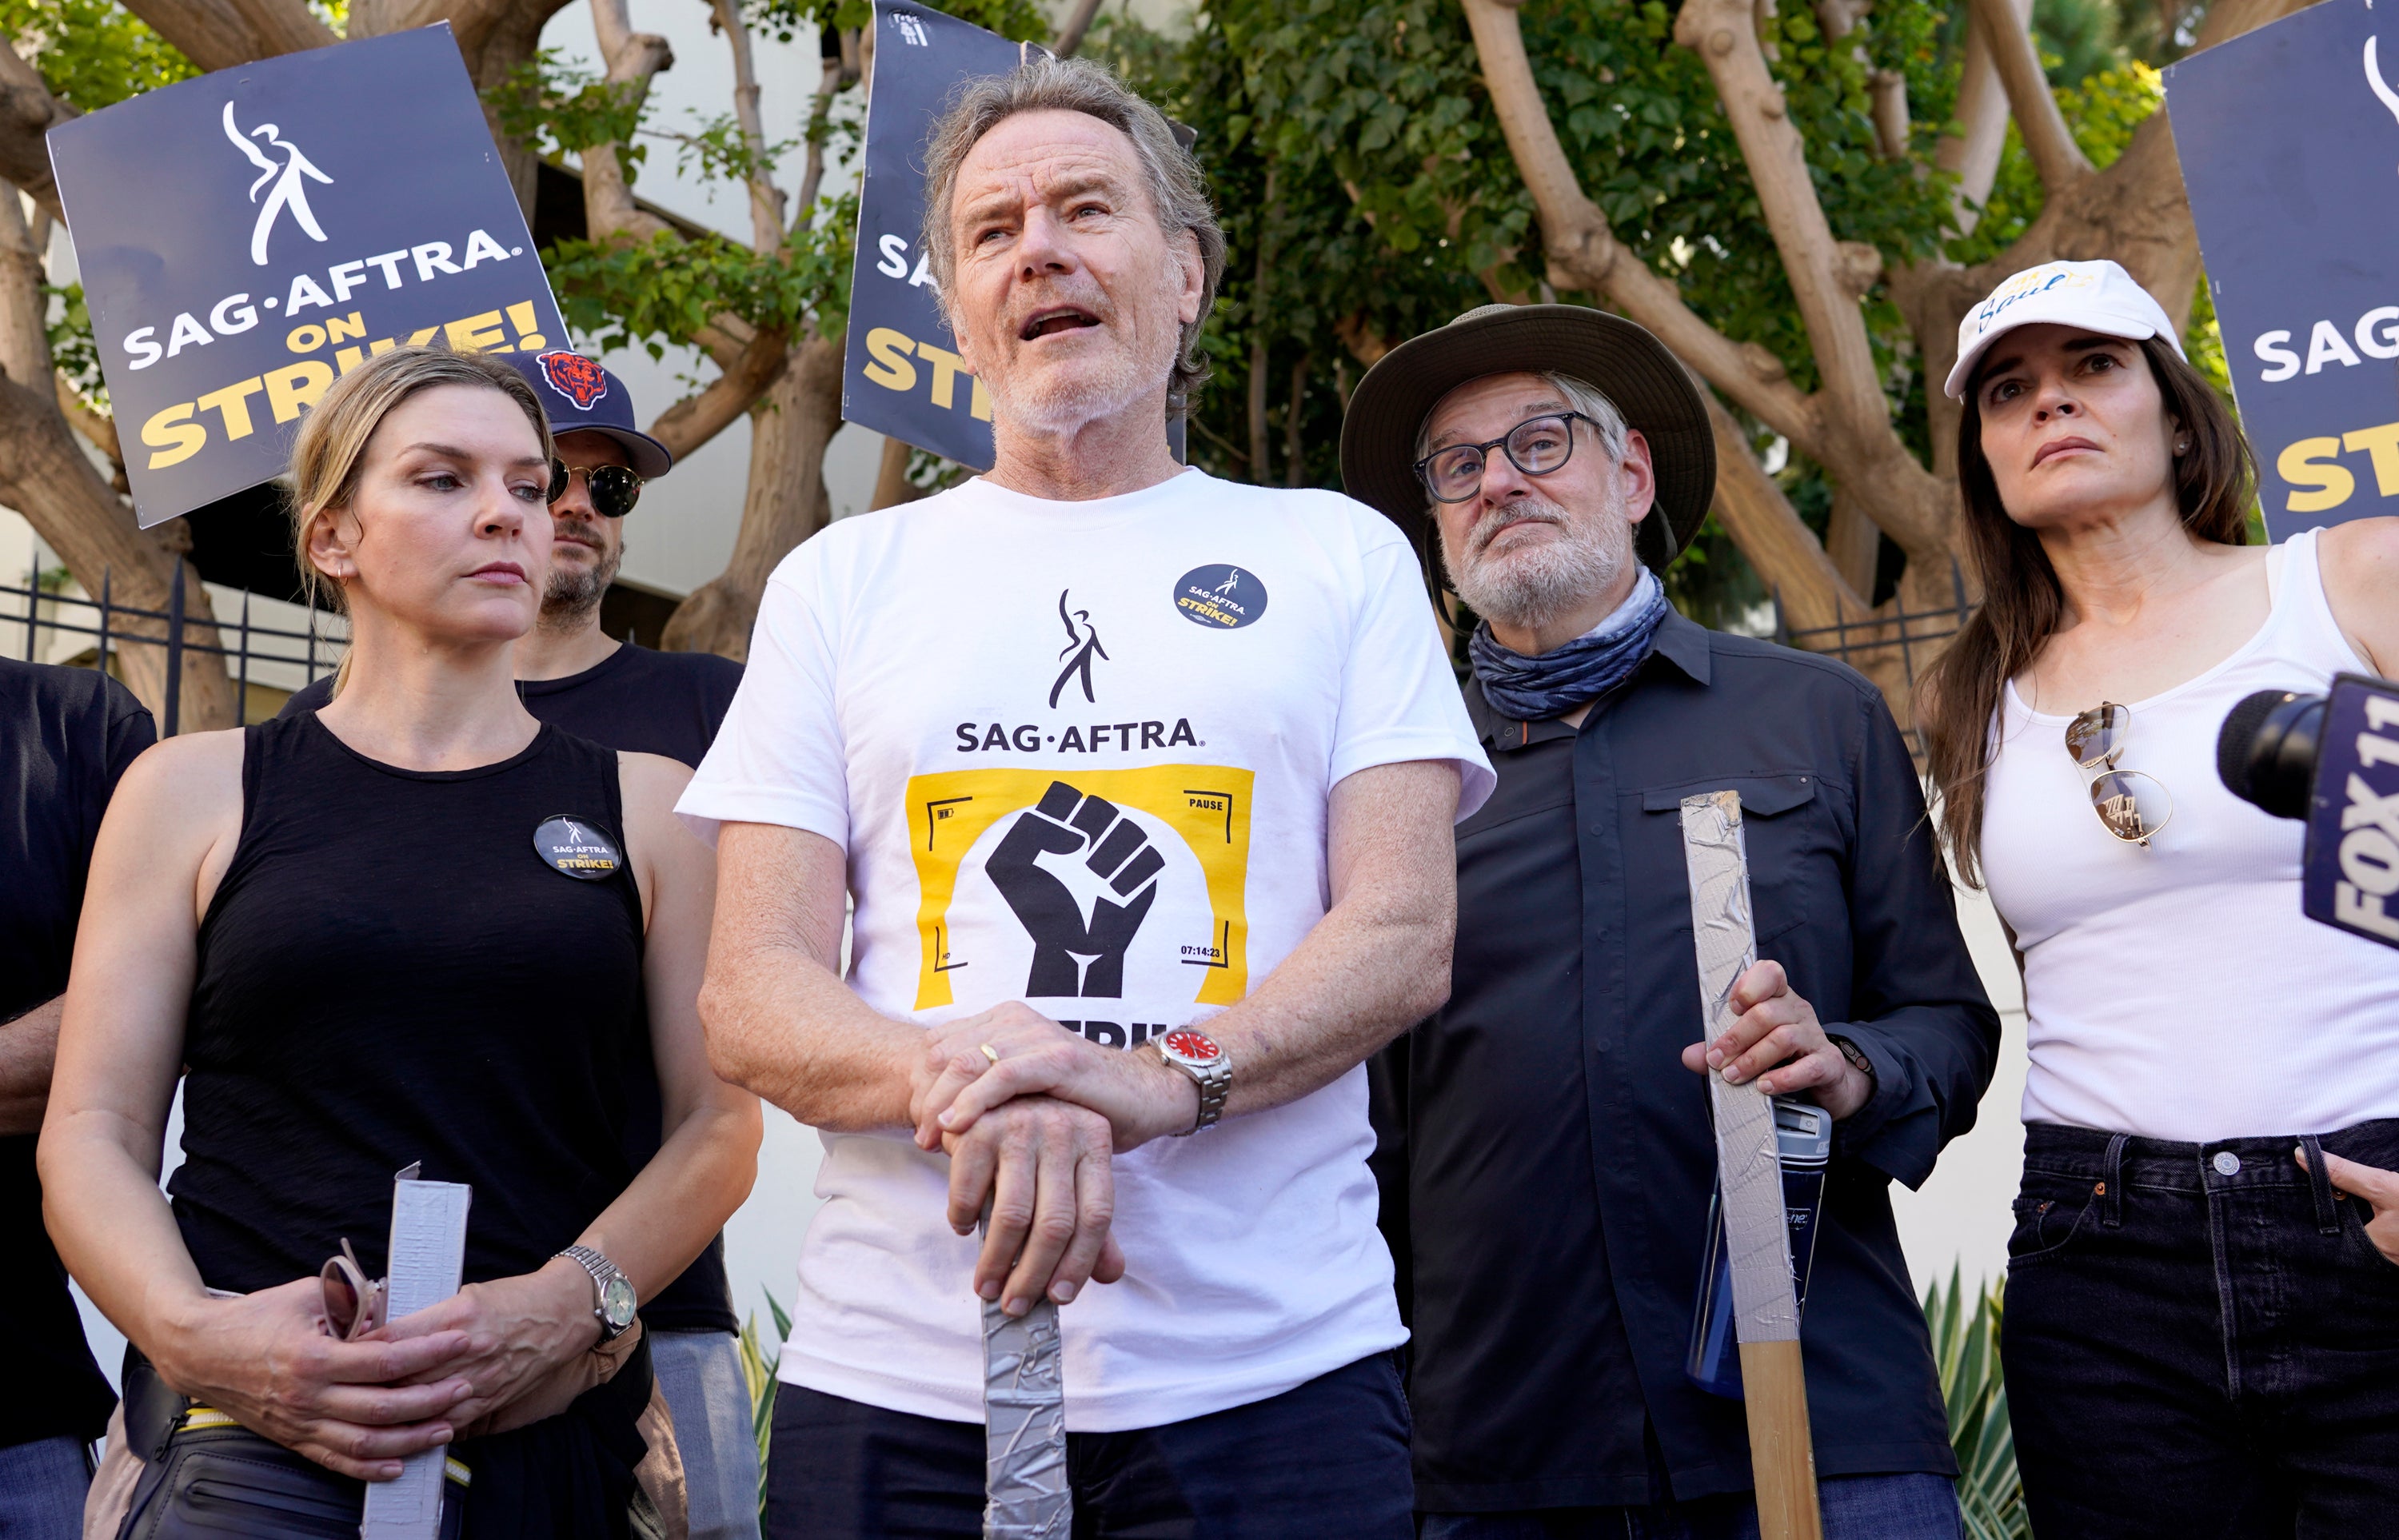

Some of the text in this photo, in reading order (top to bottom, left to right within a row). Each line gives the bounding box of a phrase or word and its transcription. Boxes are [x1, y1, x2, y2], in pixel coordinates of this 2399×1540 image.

[1978, 274, 2066, 334] Saul
[286, 312, 366, 353] ON
[1178, 597, 1238, 627] STRIKE!
[1189, 798, 1223, 811] PAUSE
[557, 859, 614, 870] STRIKE!
[2335, 772, 2399, 933] FOX
[1181, 945, 1220, 958] 07:14:23
